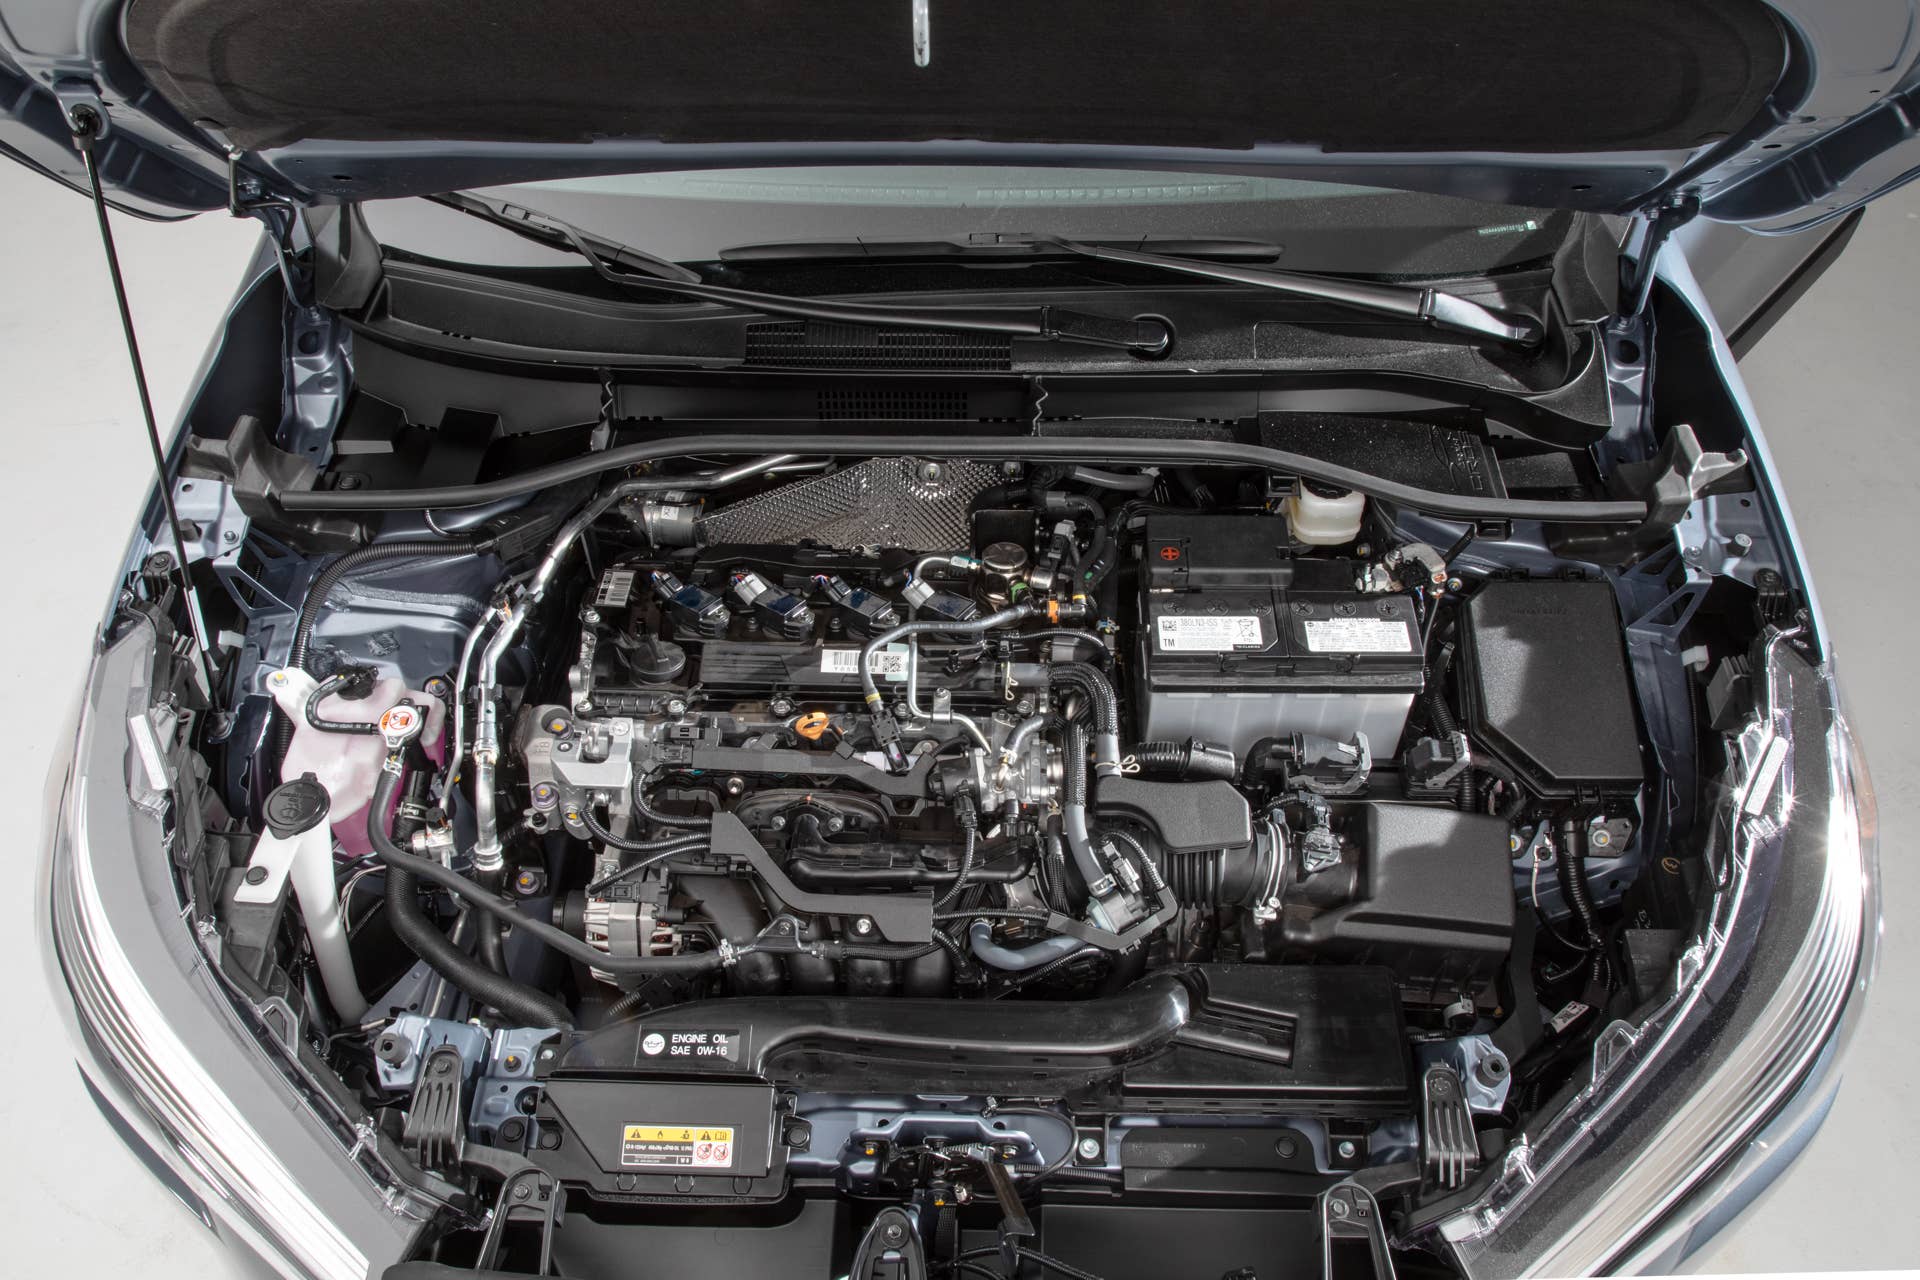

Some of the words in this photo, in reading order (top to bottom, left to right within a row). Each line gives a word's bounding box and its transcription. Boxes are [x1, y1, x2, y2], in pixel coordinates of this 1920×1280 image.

[1163, 638, 1176, 647] TM
[671, 1033, 707, 1043] ENGINE
[712, 1034, 729, 1044] OIL
[670, 1045, 691, 1055] SAE
[697, 1046, 728, 1056] 0W-16
